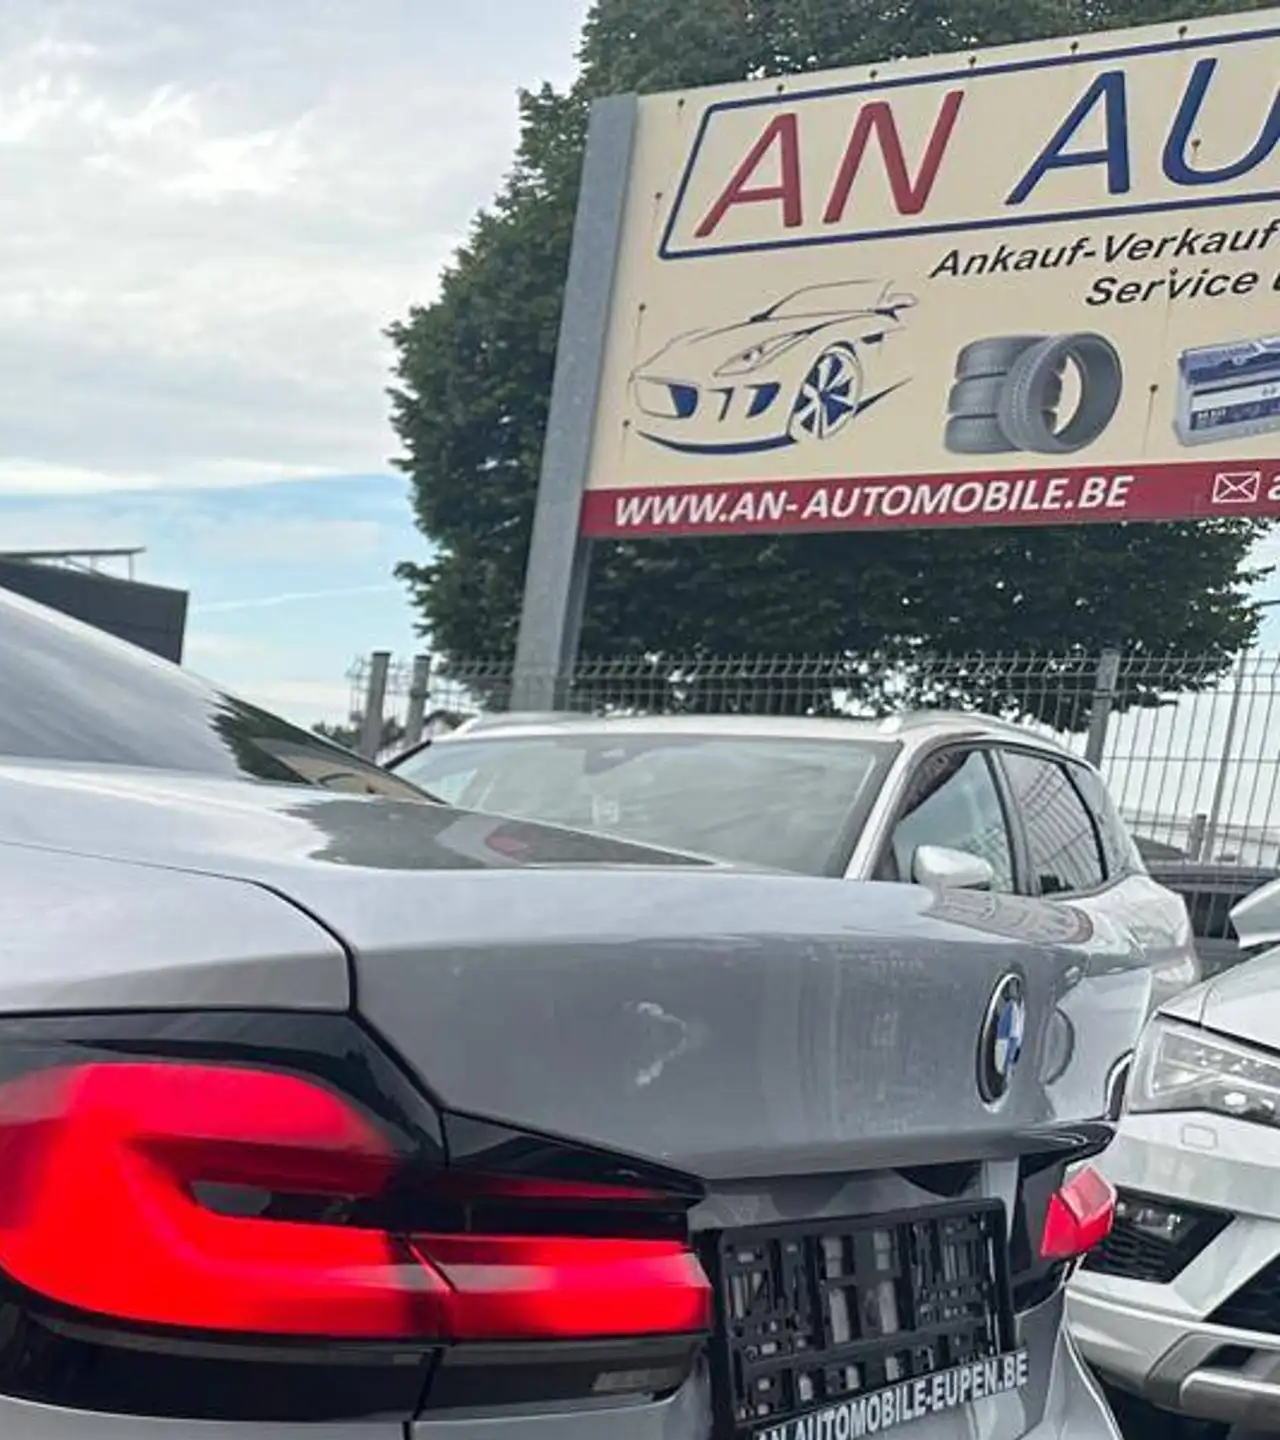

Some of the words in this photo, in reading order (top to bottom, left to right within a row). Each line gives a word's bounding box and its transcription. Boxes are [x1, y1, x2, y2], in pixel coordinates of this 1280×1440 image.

[694, 90, 964, 239] AN
[928, 219, 1280, 279] Ankauf-Verkauf
[1085, 267, 1258, 306] Service
